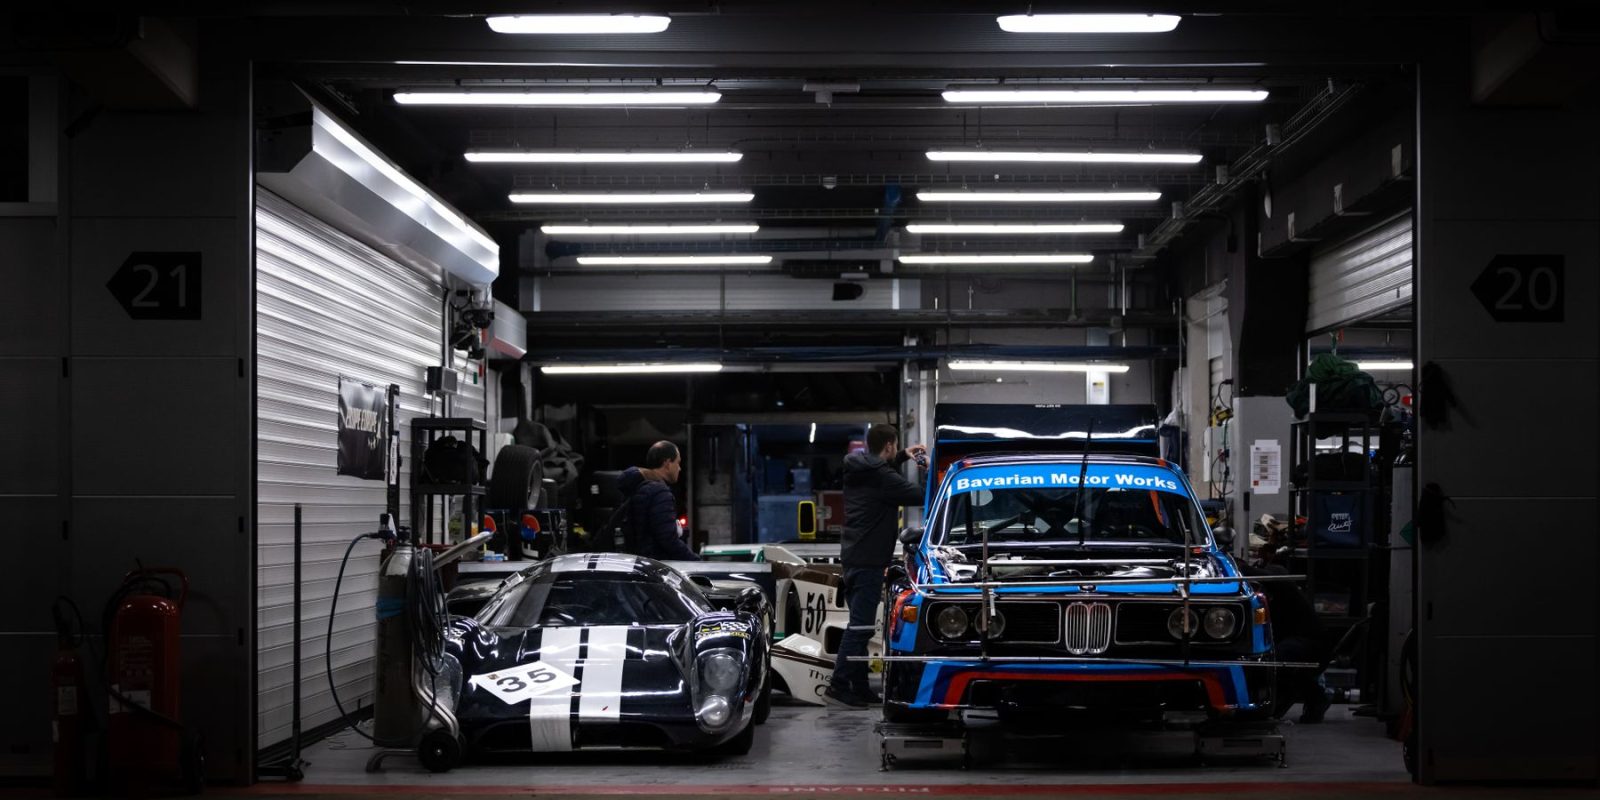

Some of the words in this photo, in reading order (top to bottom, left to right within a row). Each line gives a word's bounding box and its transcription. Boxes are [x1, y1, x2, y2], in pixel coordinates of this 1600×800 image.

[132, 263, 187, 307] 21
[1495, 266, 1558, 311] 20
[957, 473, 1044, 490] Bavarian
[1051, 473, 1110, 485] Motor
[1114, 473, 1177, 490] Works
[805, 592, 826, 635] 50
[496, 668, 557, 692] 35
